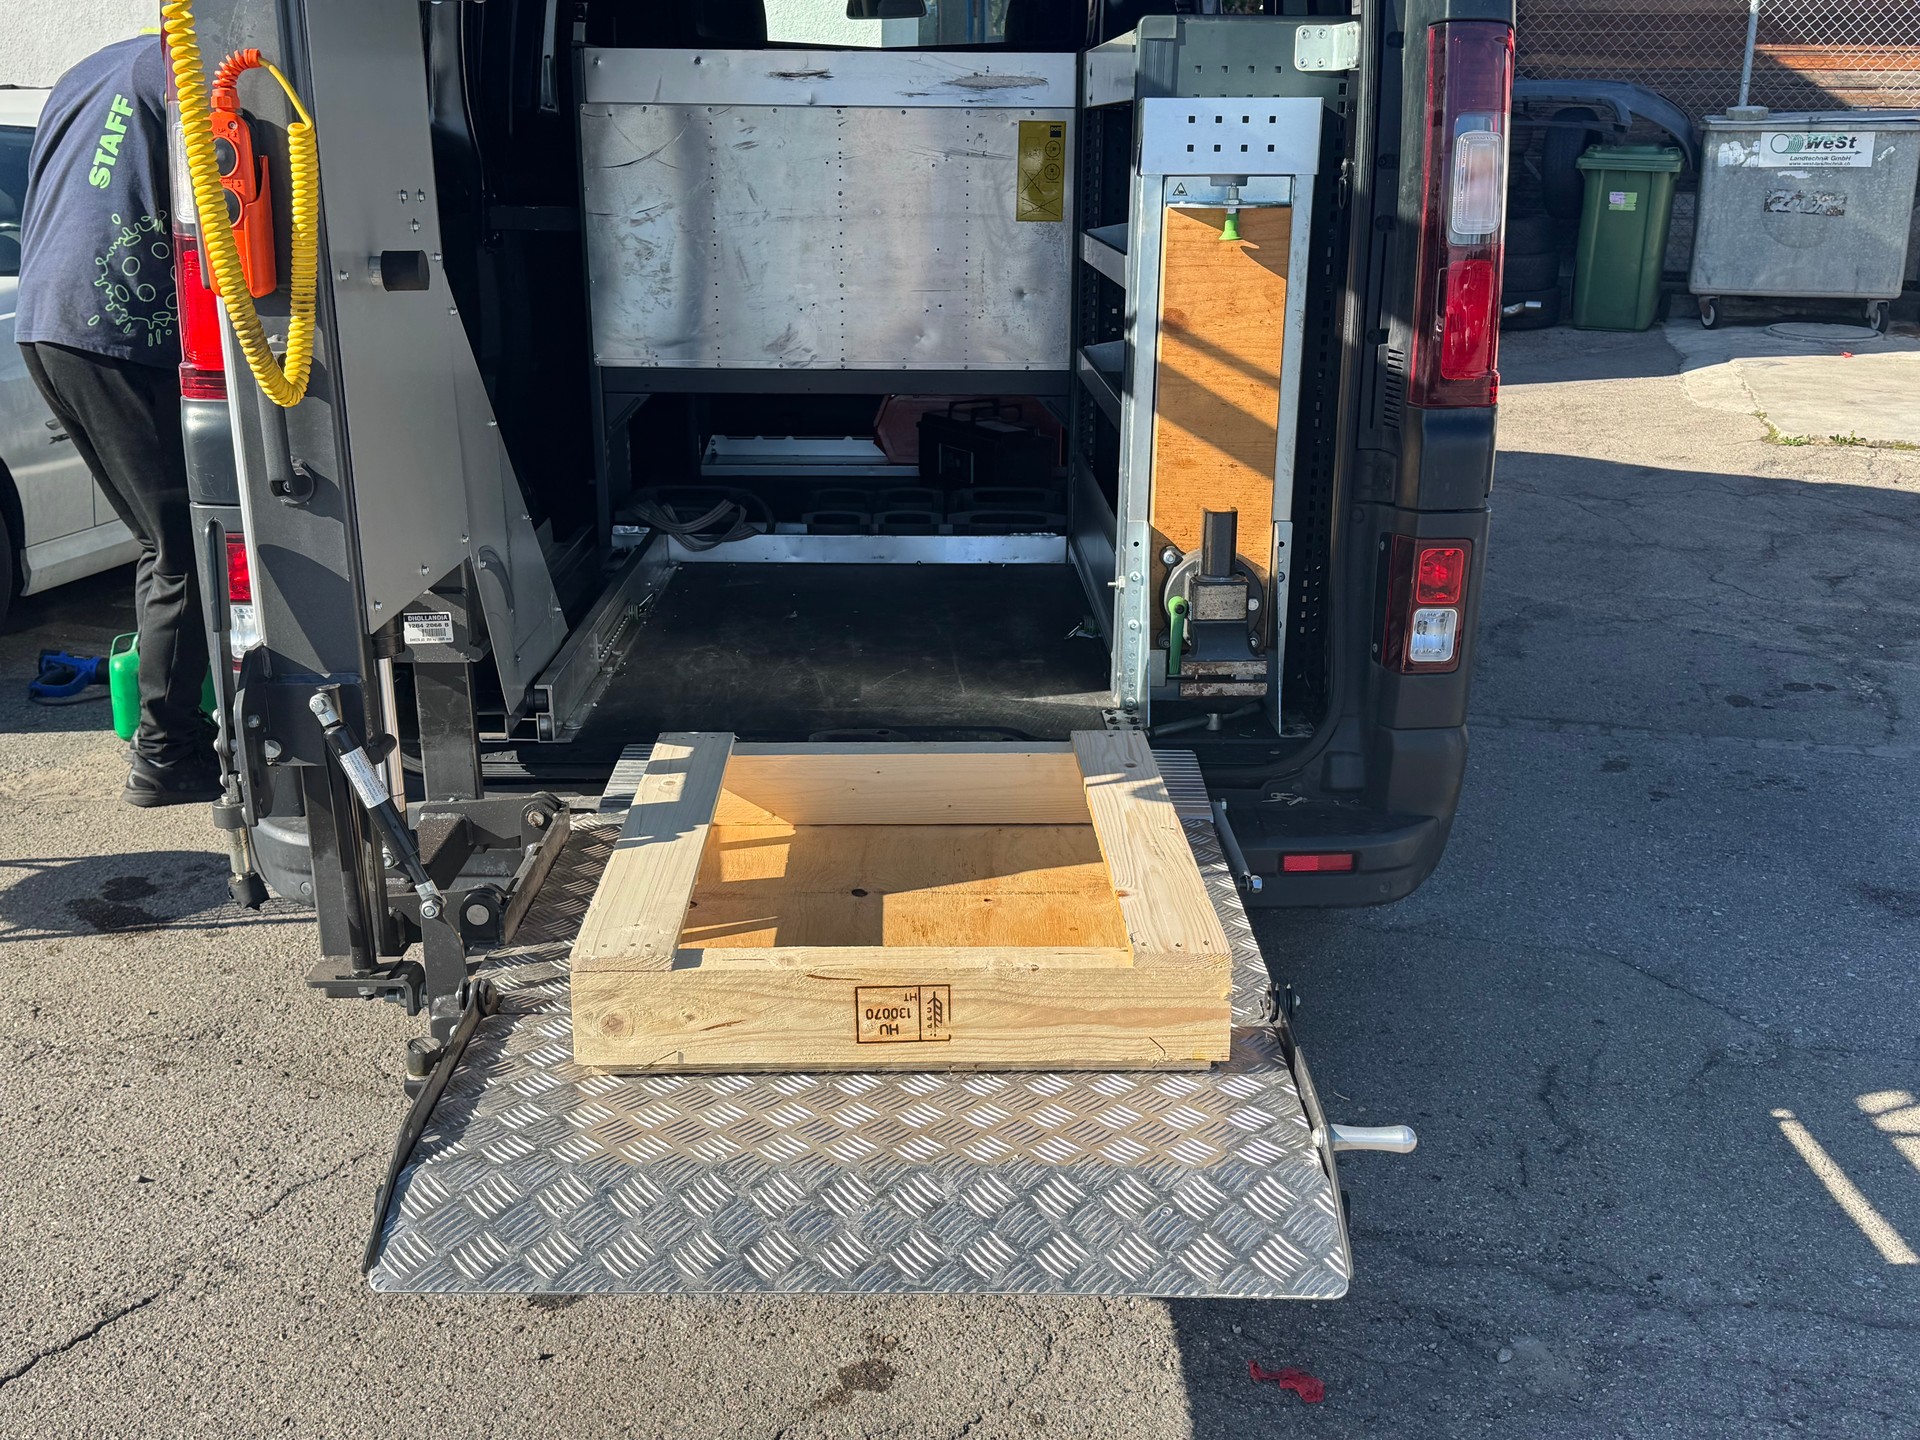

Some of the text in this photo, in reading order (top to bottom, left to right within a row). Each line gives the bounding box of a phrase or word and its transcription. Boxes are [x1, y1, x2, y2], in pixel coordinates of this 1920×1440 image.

[88, 93, 134, 189] STAFF
[903, 992, 918, 1002] HT
[865, 1007, 911, 1020] 130070
[879, 1023, 899, 1036] HU
